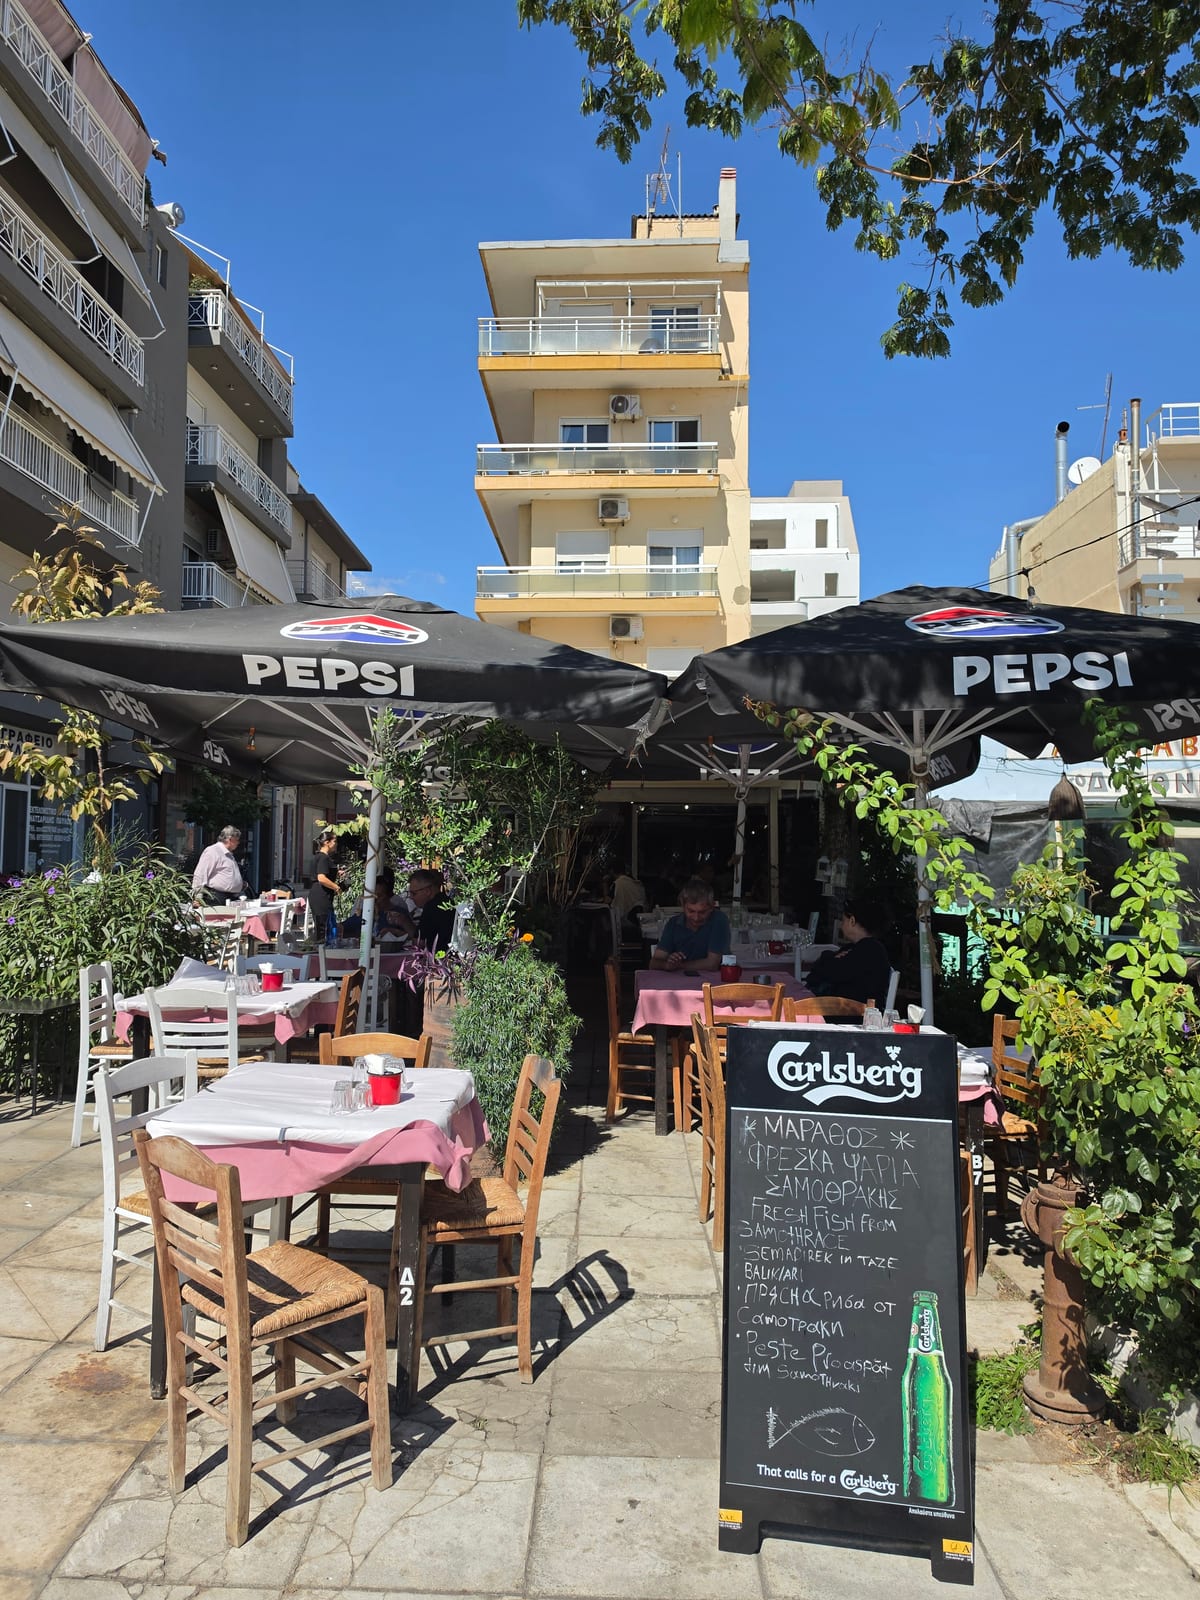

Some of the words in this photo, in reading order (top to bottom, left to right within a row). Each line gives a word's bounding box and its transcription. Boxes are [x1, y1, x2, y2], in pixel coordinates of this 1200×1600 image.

[290, 624, 420, 641] PEPSI
[923, 616, 1051, 631] PEPSI
[242, 653, 415, 697] PEPSI
[952, 651, 1134, 696] PEPSI
[767, 1040, 923, 1104] Carlsberg
[765, 1115, 885, 1149] ΜΑΡΑΘΟΣ
[749, 1141, 834, 1174] ΦΡΕΣΚΑ
[843, 1152, 921, 1188] ΨΑΡΙΑ
[765, 1174, 903, 1210] ΣΑΜΟΘΡΑΚΗΣ
[751, 1196, 808, 1225] FRESH
[860, 1213, 898, 1233] FROM
[857, 1255, 899, 1270] TAZE
[918, 1309, 935, 1351] Carlsberg
[756, 1463, 782, 1478] That
[784, 1468, 809, 1482] calls
[811, 1471, 826, 1483] for
[829, 1475, 836, 1484] a
[840, 1469, 897, 1496] Carlsberg
